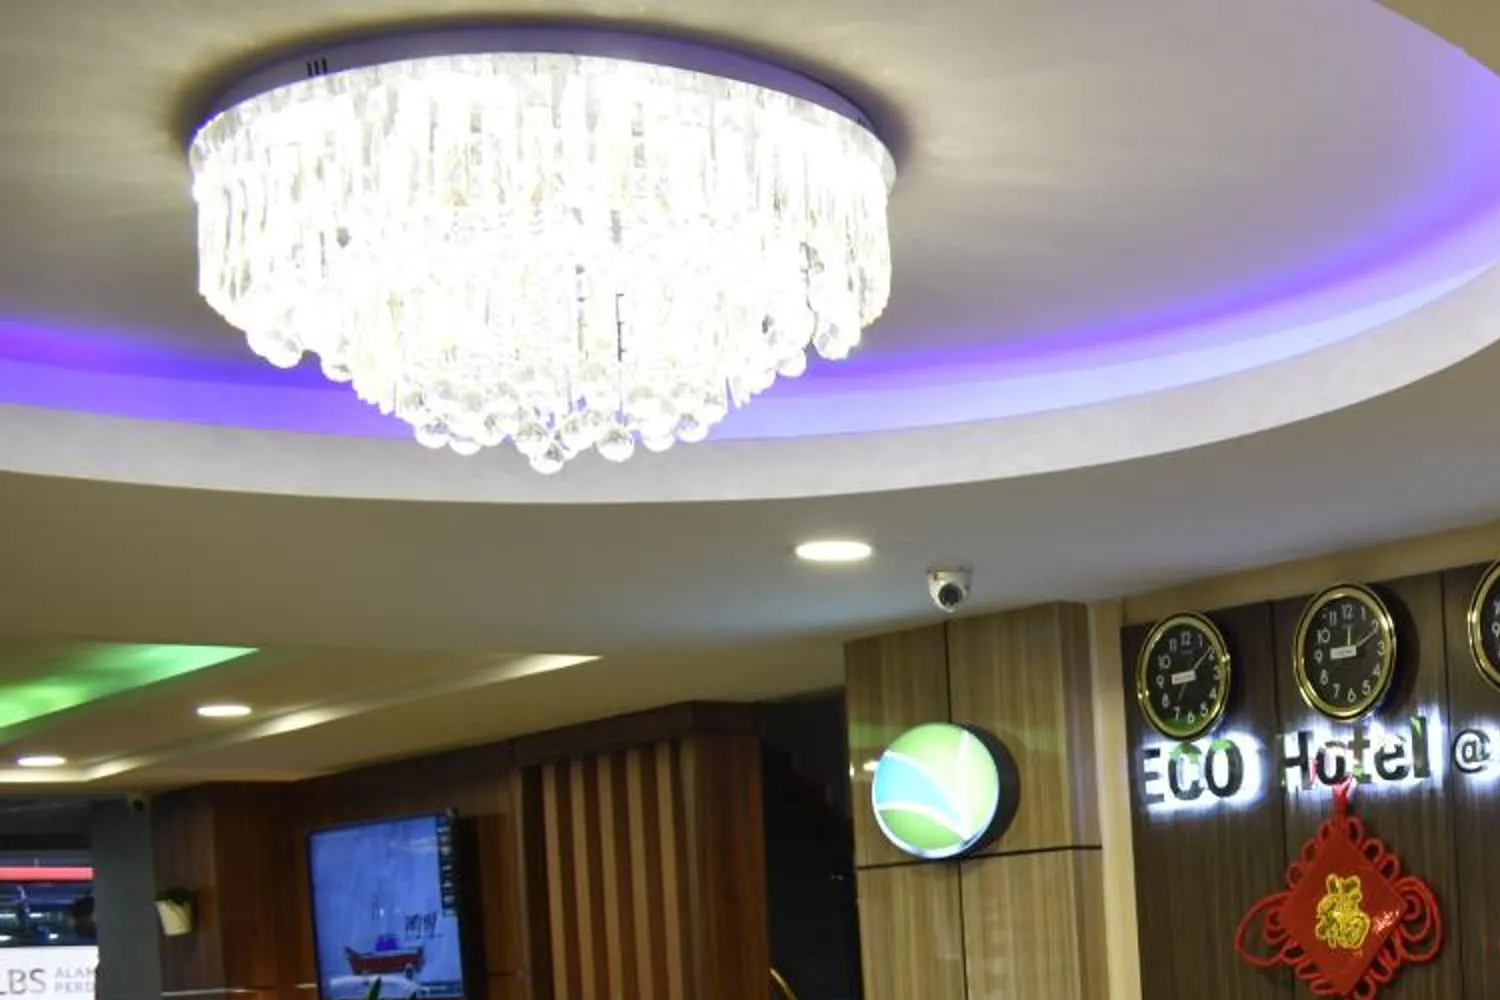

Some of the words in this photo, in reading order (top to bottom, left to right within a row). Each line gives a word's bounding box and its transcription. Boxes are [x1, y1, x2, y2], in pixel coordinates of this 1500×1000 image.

[1142, 739, 1244, 804] ECO
[1279, 716, 1431, 791] Hotel
[1453, 728, 1491, 774] @
